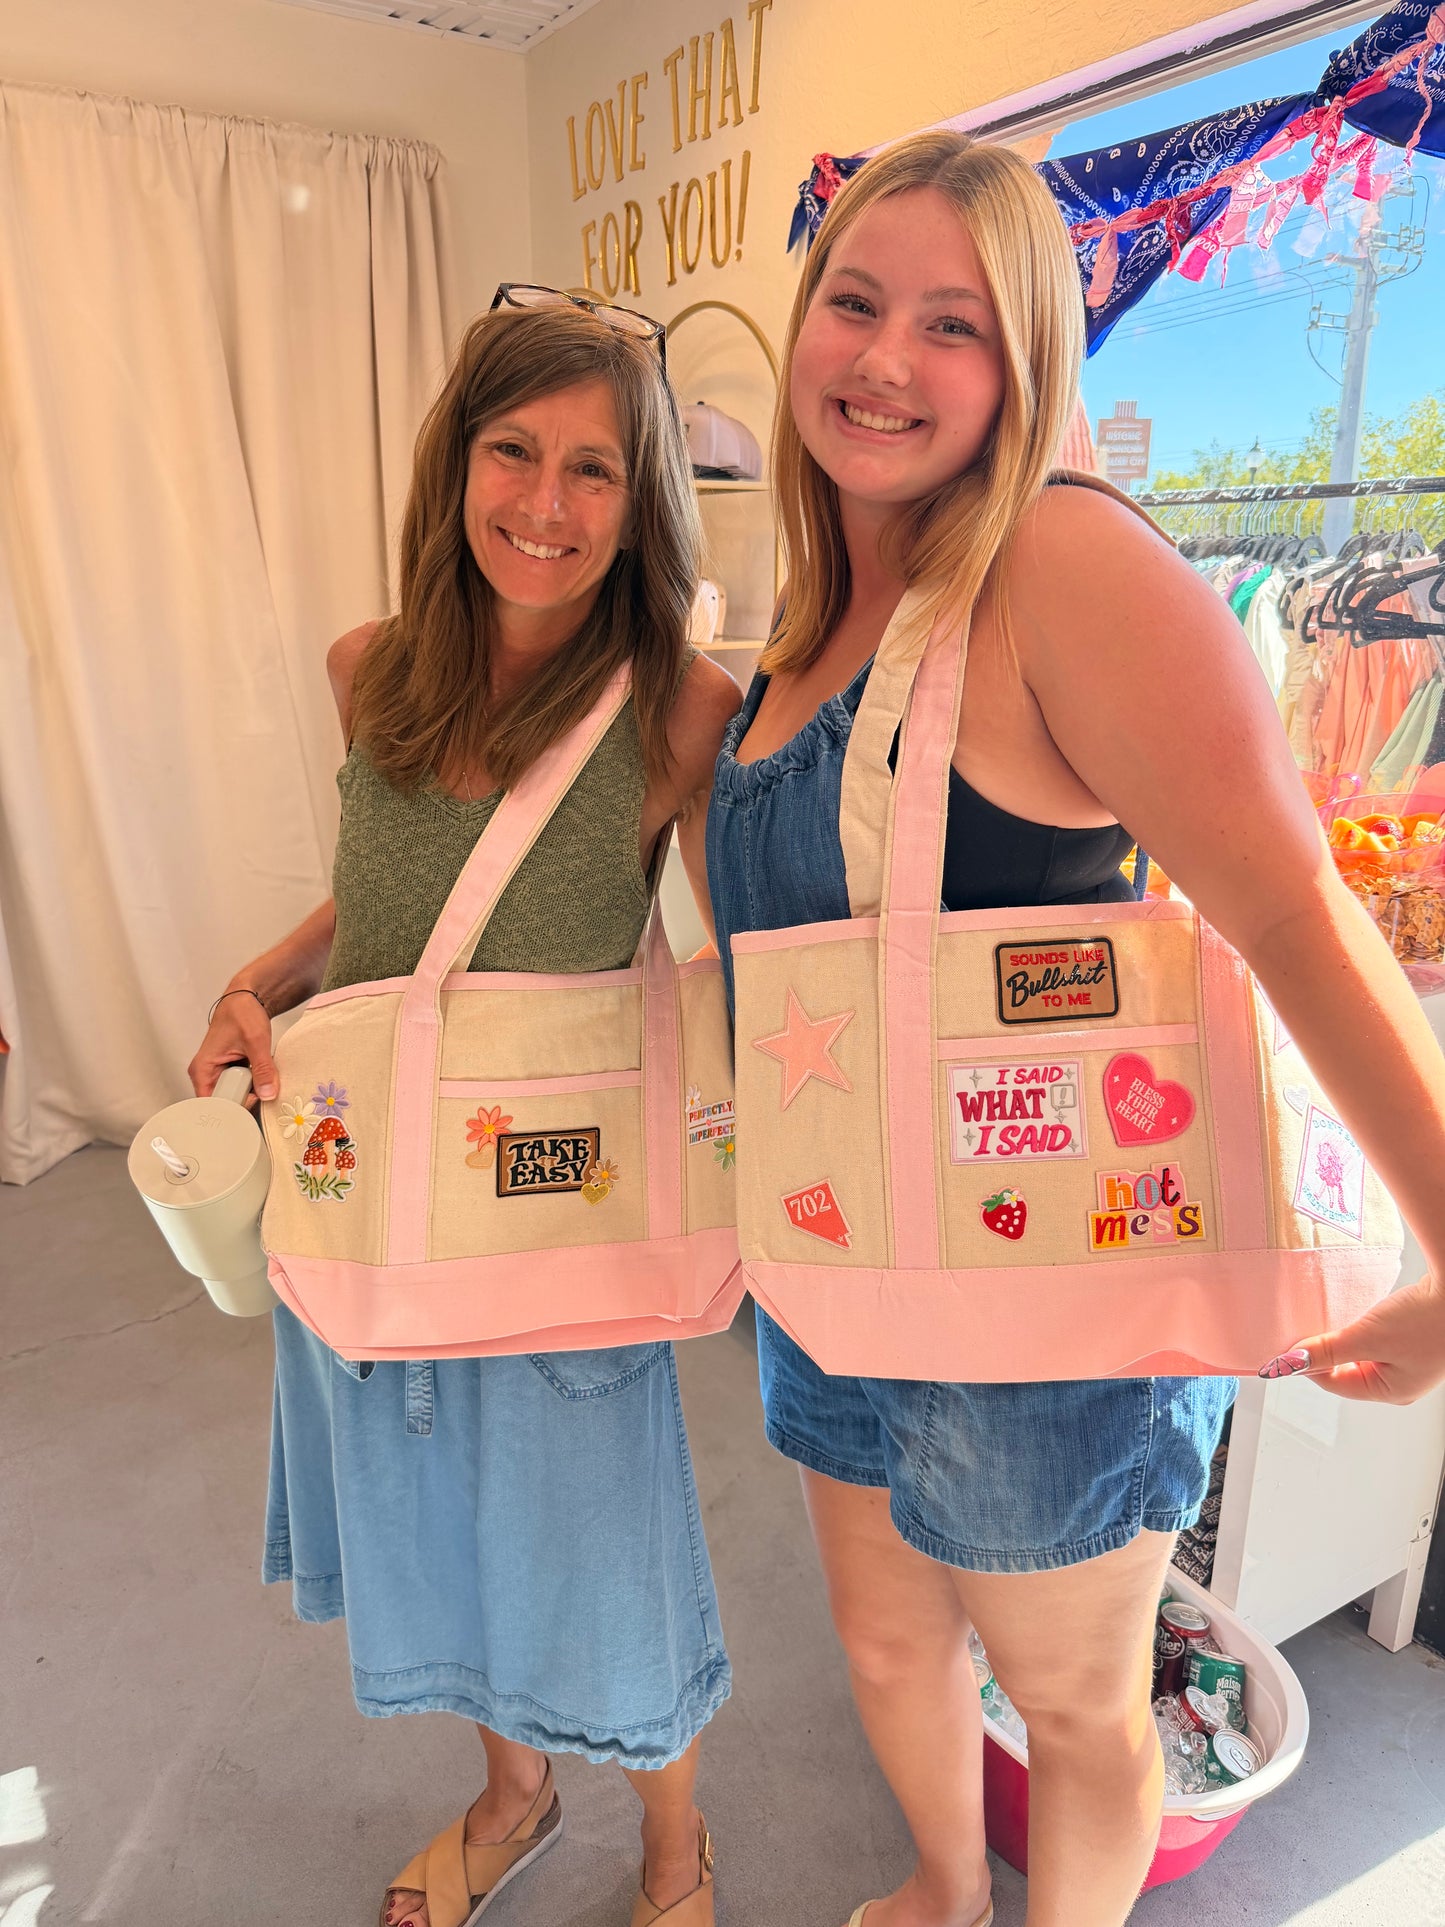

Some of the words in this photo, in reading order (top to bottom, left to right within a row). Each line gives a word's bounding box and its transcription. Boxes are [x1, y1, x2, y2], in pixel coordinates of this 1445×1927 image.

[566, 71, 648, 201] LOVE
[663, 0, 773, 153] THAT
[581, 200, 642, 298] FOR
[658, 150, 751, 287] YOU!
[1010, 951, 1069, 967] SOUNDS
[1073, 948, 1105, 963] LIKE
[1006, 960, 1108, 1008] Bullshit
[1041, 994, 1063, 1008] TO
[1067, 992, 1092, 1006] ME
[996, 1068, 1010, 1085] I
[1013, 1066, 1064, 1085] SAID
[956, 1088, 1047, 1122] WHAT
[1125, 1089, 1158, 1122] YOUR
[1130, 1077, 1166, 1109] BLESS
[689, 1100, 733, 1123] PERFECTLY
[1115, 1099, 1156, 1134] HEART
[689, 1122, 736, 1144] IMPERFECT
[973, 1125, 996, 1156] I
[996, 1124, 1072, 1156] SAID
[508, 1138, 590, 1165] TAKE
[509, 1159, 588, 1188] EASY
[1104, 1167, 1181, 1211] hot
[789, 1189, 832, 1221] 702
[1095, 1205, 1200, 1244] mess
